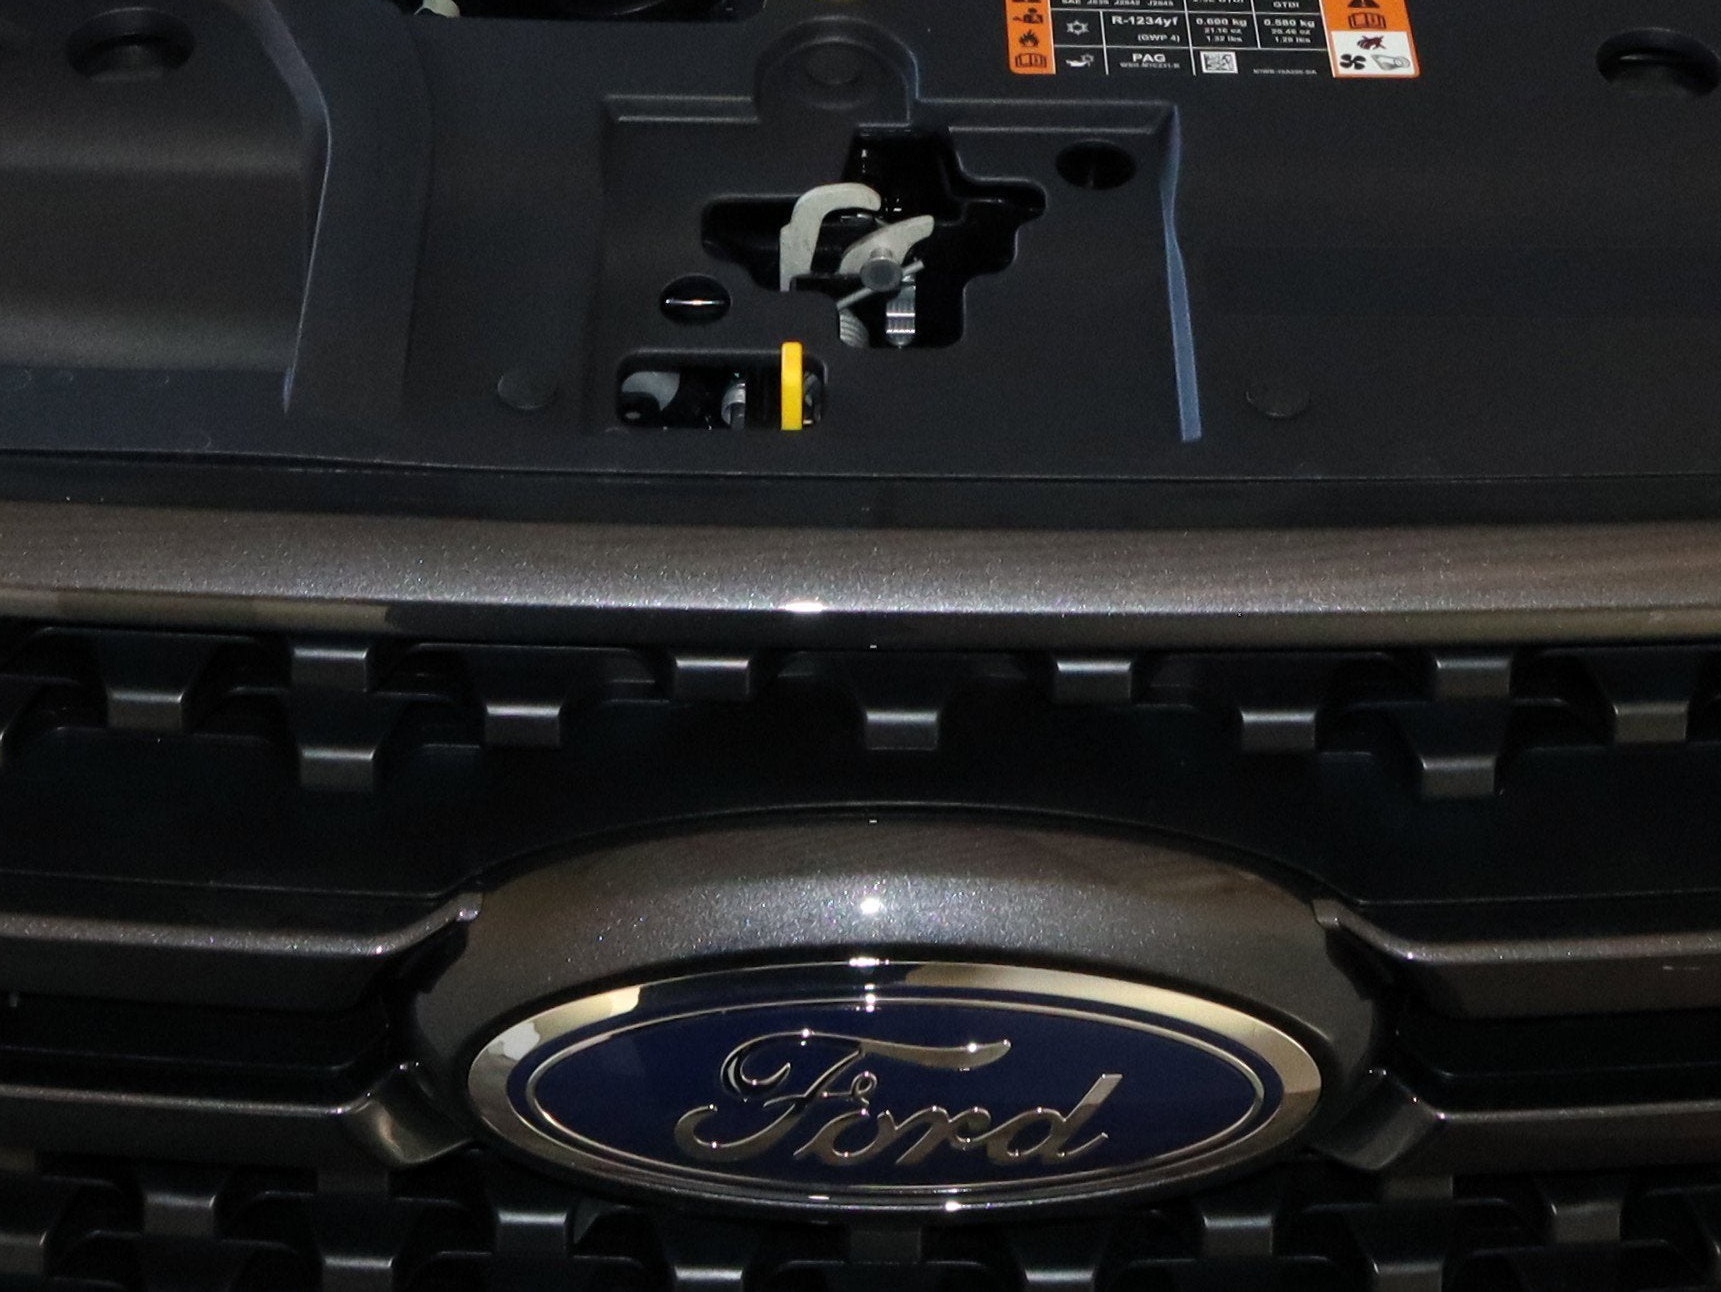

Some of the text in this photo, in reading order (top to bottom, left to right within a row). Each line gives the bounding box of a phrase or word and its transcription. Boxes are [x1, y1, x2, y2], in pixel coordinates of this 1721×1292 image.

[1111, 15, 1178, 27] R-1234yf
[1195, 17, 1248, 28] 0.600 kg
[1299, 19, 1316, 29] kg
[1137, 33, 1181, 43] (GWP 4)
[1227, 35, 1243, 43] lbs
[1295, 36, 1311, 44] lbs
[1131, 52, 1167, 63] PAG
[673, 1030, 1122, 1168] Ford
